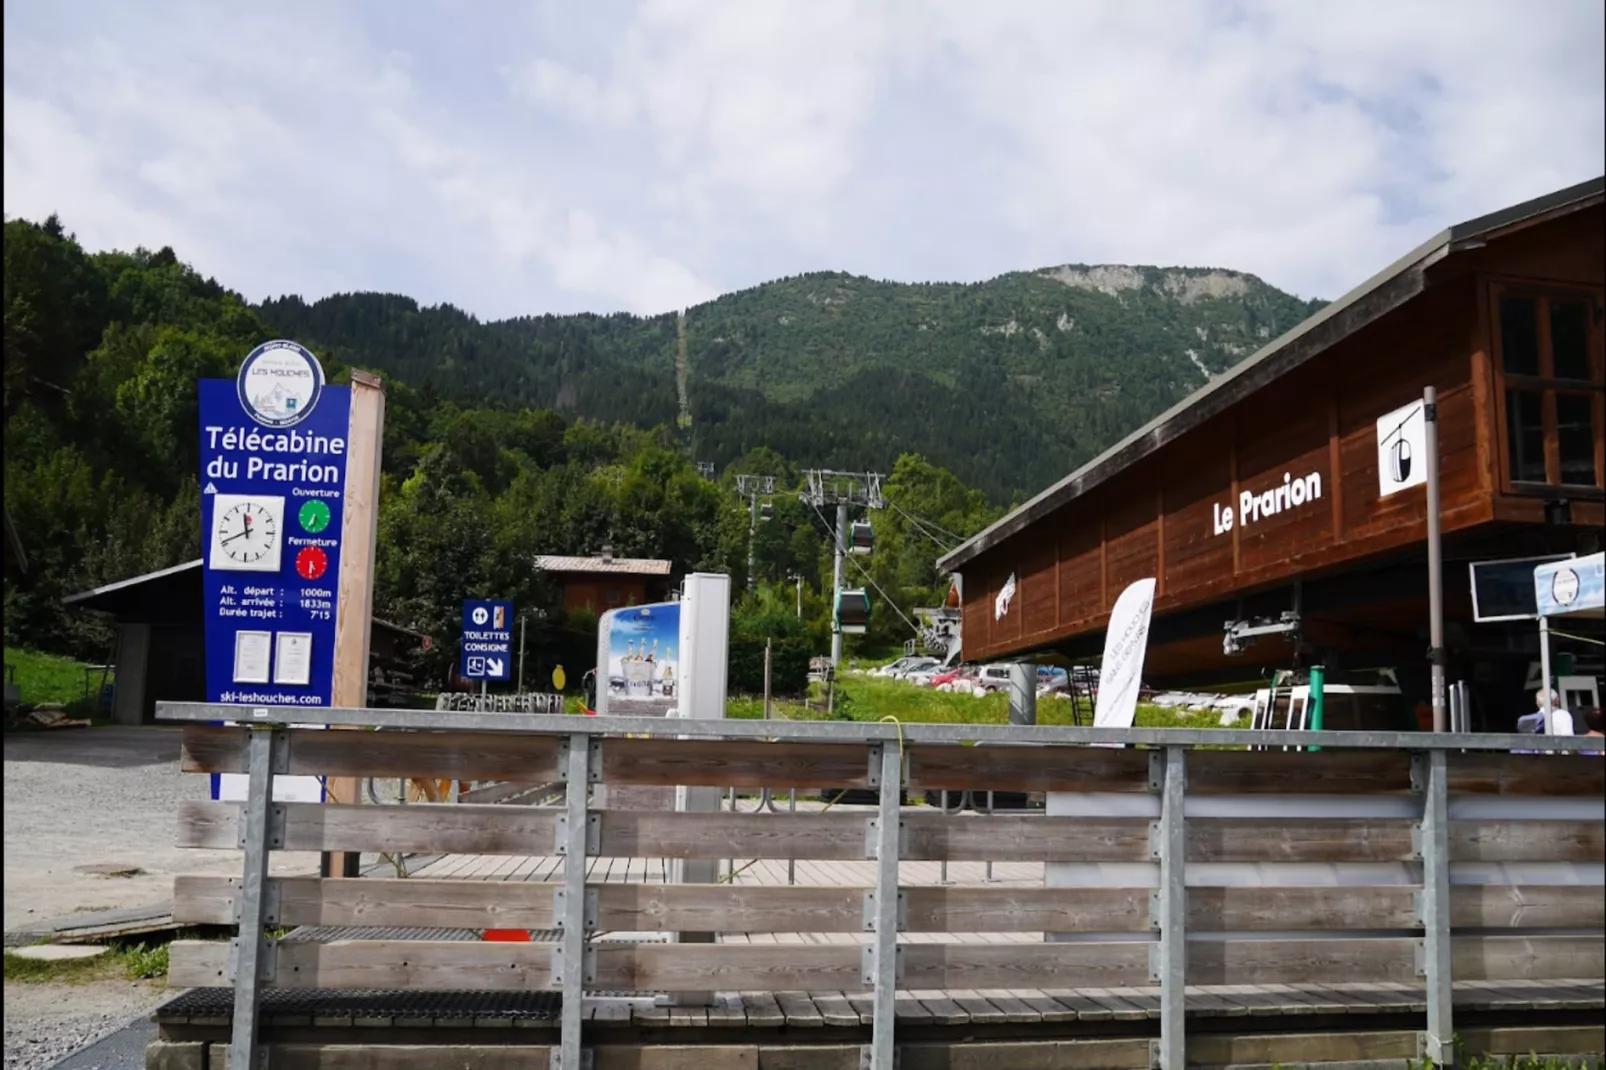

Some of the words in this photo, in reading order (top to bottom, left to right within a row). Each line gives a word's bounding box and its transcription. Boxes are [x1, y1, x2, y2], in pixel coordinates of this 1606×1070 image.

[206, 426, 345, 454] Télécabine
[206, 455, 238, 479] du
[247, 457, 339, 483] Prarion
[292, 486, 340, 498] Ouverture
[1213, 502, 1234, 536] Le
[1239, 471, 1322, 527] Prarion
[288, 536, 338, 547] Fermeture
[220, 585, 237, 595] Alt.
[243, 586, 275, 597] départ
[300, 588, 332, 597] 1000m
[219, 596, 236, 605] Alt.
[241, 597, 275, 607] arrivée
[299, 599, 331, 608] 1833m
[219, 607, 247, 617] Durée
[250, 609, 277, 619] trajet
[310, 610, 331, 620] 7'15
[463, 631, 510, 641] TOILETTES
[464, 642, 508, 653] CONSIGNE
[220, 691, 322, 705] ski-leshouches.com
